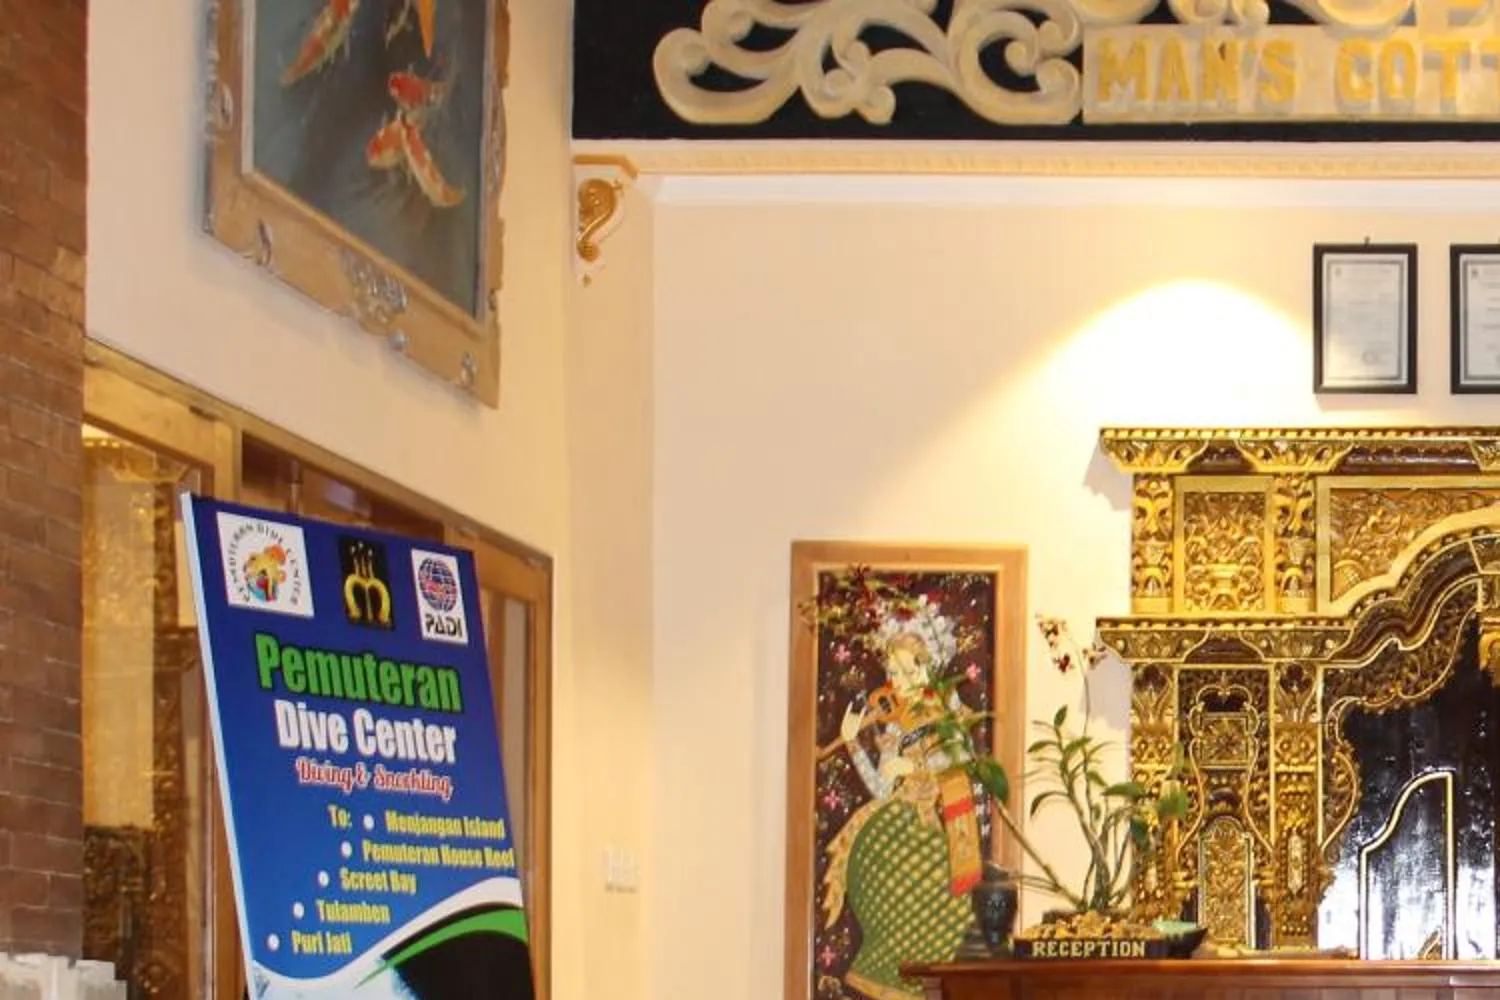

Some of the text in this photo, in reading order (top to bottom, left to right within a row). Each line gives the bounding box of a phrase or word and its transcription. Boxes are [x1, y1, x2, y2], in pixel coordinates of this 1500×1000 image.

[424, 613, 463, 638] PADI
[255, 633, 462, 712] Pemuteran
[274, 699, 457, 764] Dive Center
[295, 757, 353, 793] Diving
[355, 762, 371, 789] &
[327, 804, 352, 829] To:
[385, 810, 506, 840] Menjangan Island
[362, 839, 439, 864] Pemuteran
[440, 844, 482, 866] House
[389, 869, 417, 895] Bay
[315, 899, 391, 924] Tulamben
[291, 930, 324, 955] Puri
[1032, 940, 1147, 958] RECEPTION
